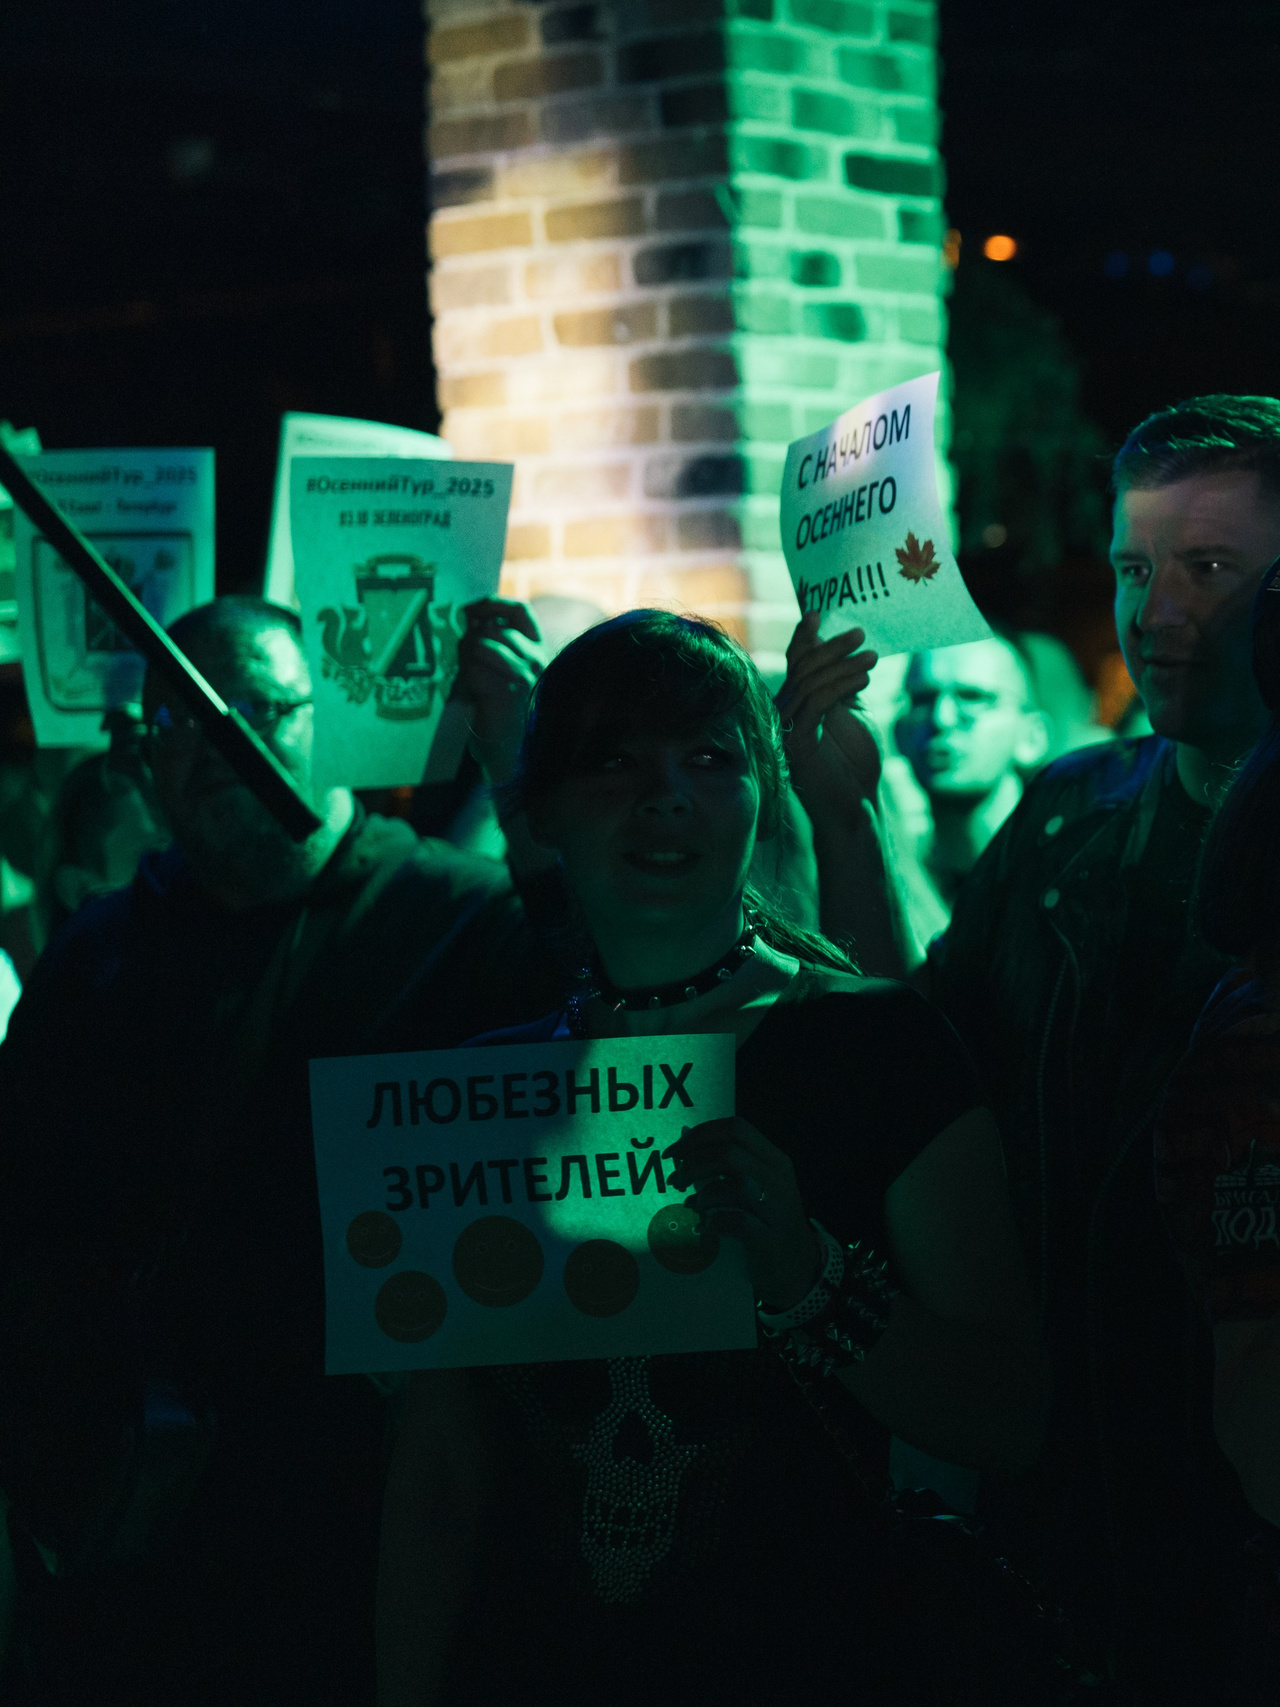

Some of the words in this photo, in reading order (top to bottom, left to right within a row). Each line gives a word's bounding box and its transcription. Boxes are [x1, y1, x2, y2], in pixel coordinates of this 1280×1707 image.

[798, 453, 813, 490] С
[813, 403, 911, 484] НАЧАЛОМ
[306, 475, 495, 499] #ОсеннийТур_2025
[796, 476, 897, 550] ОСЕННЕГО
[810, 562, 890, 612] ТУРА!!!
[366, 1062, 695, 1130] ЛЮБЕЗНЫХ
[382, 1136, 667, 1213] ЗРИТЕЛЕЙ
